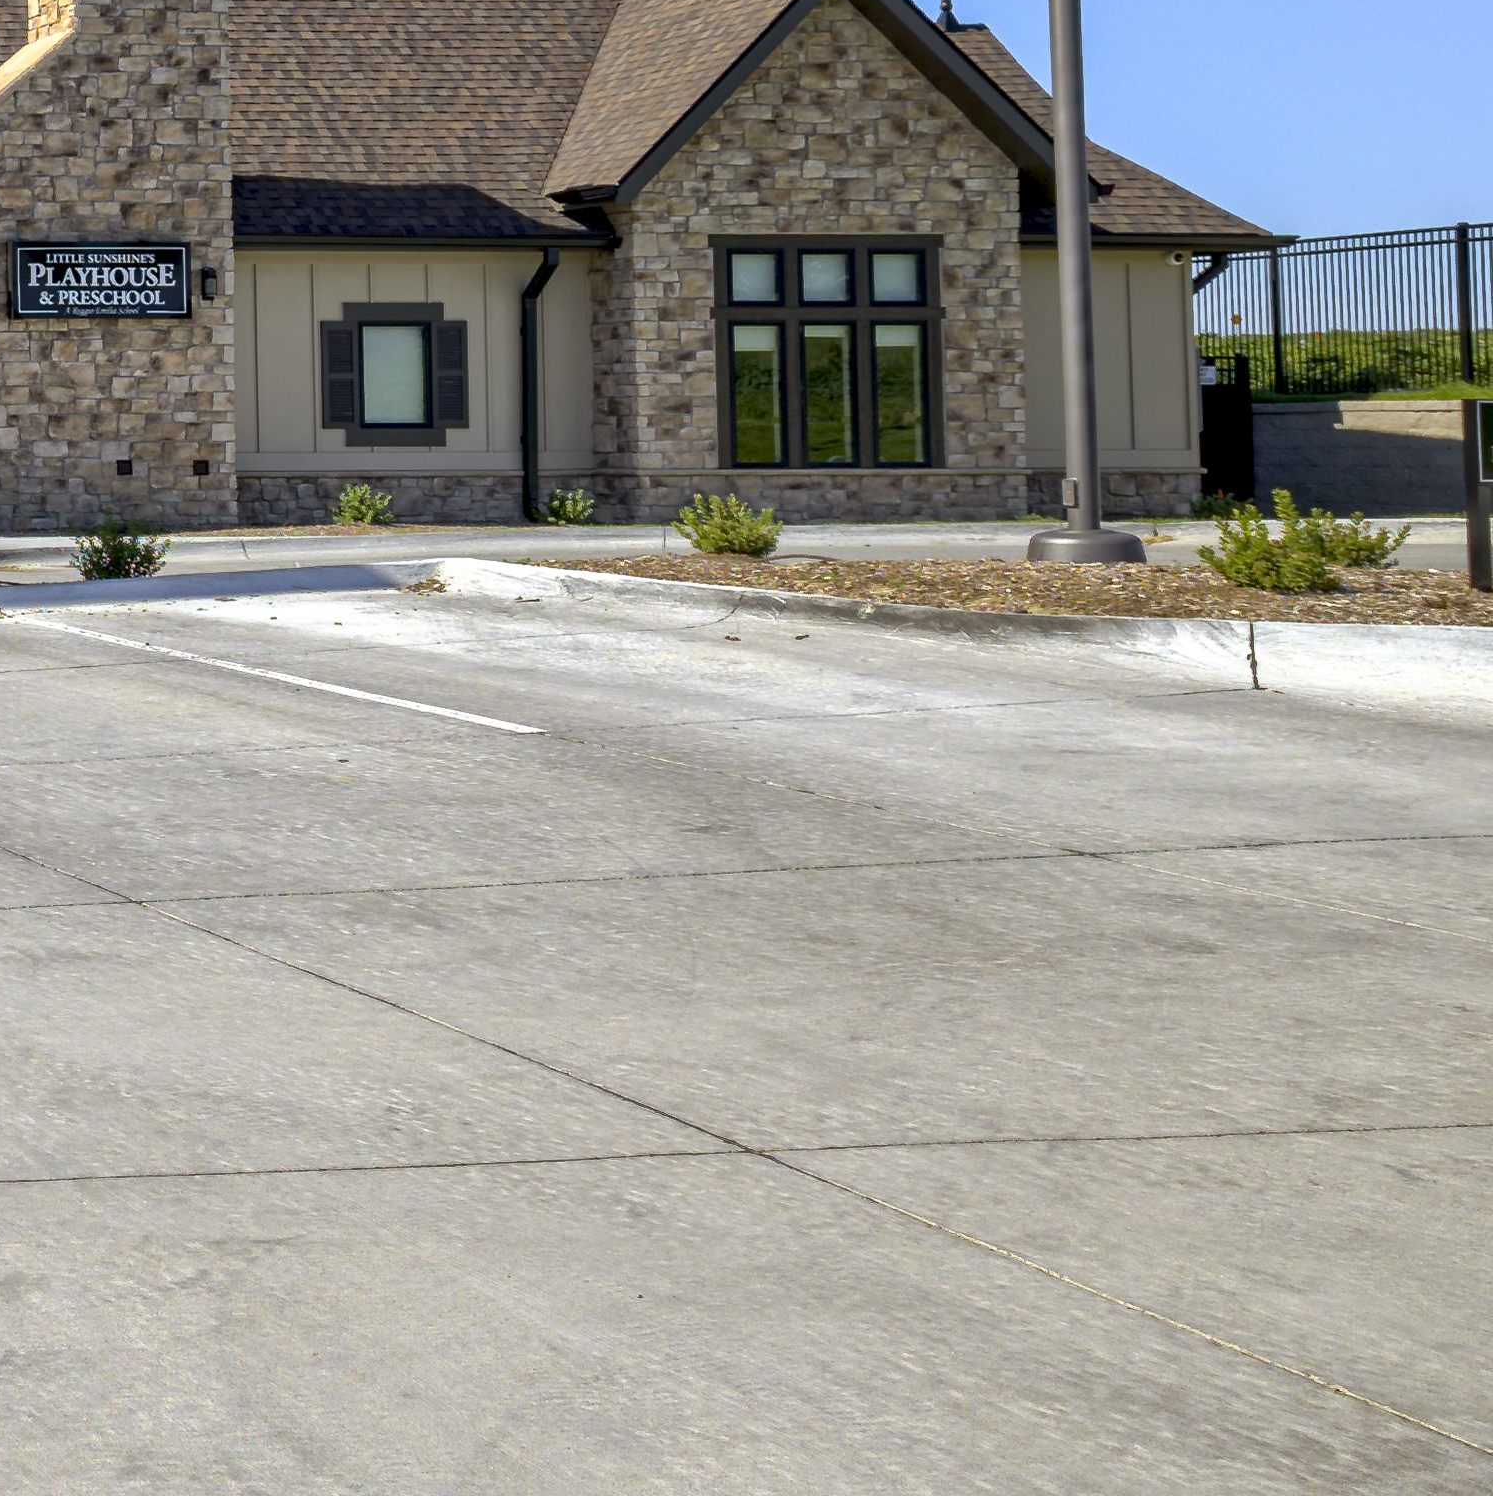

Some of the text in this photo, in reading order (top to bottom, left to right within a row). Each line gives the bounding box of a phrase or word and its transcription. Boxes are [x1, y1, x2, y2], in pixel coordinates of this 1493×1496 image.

[46, 253, 156, 264] LITTLE SUNSHINE'S
[28, 263, 176, 287] PLAYHOUSE
[39, 290, 165, 305] & PRESCHOOL
